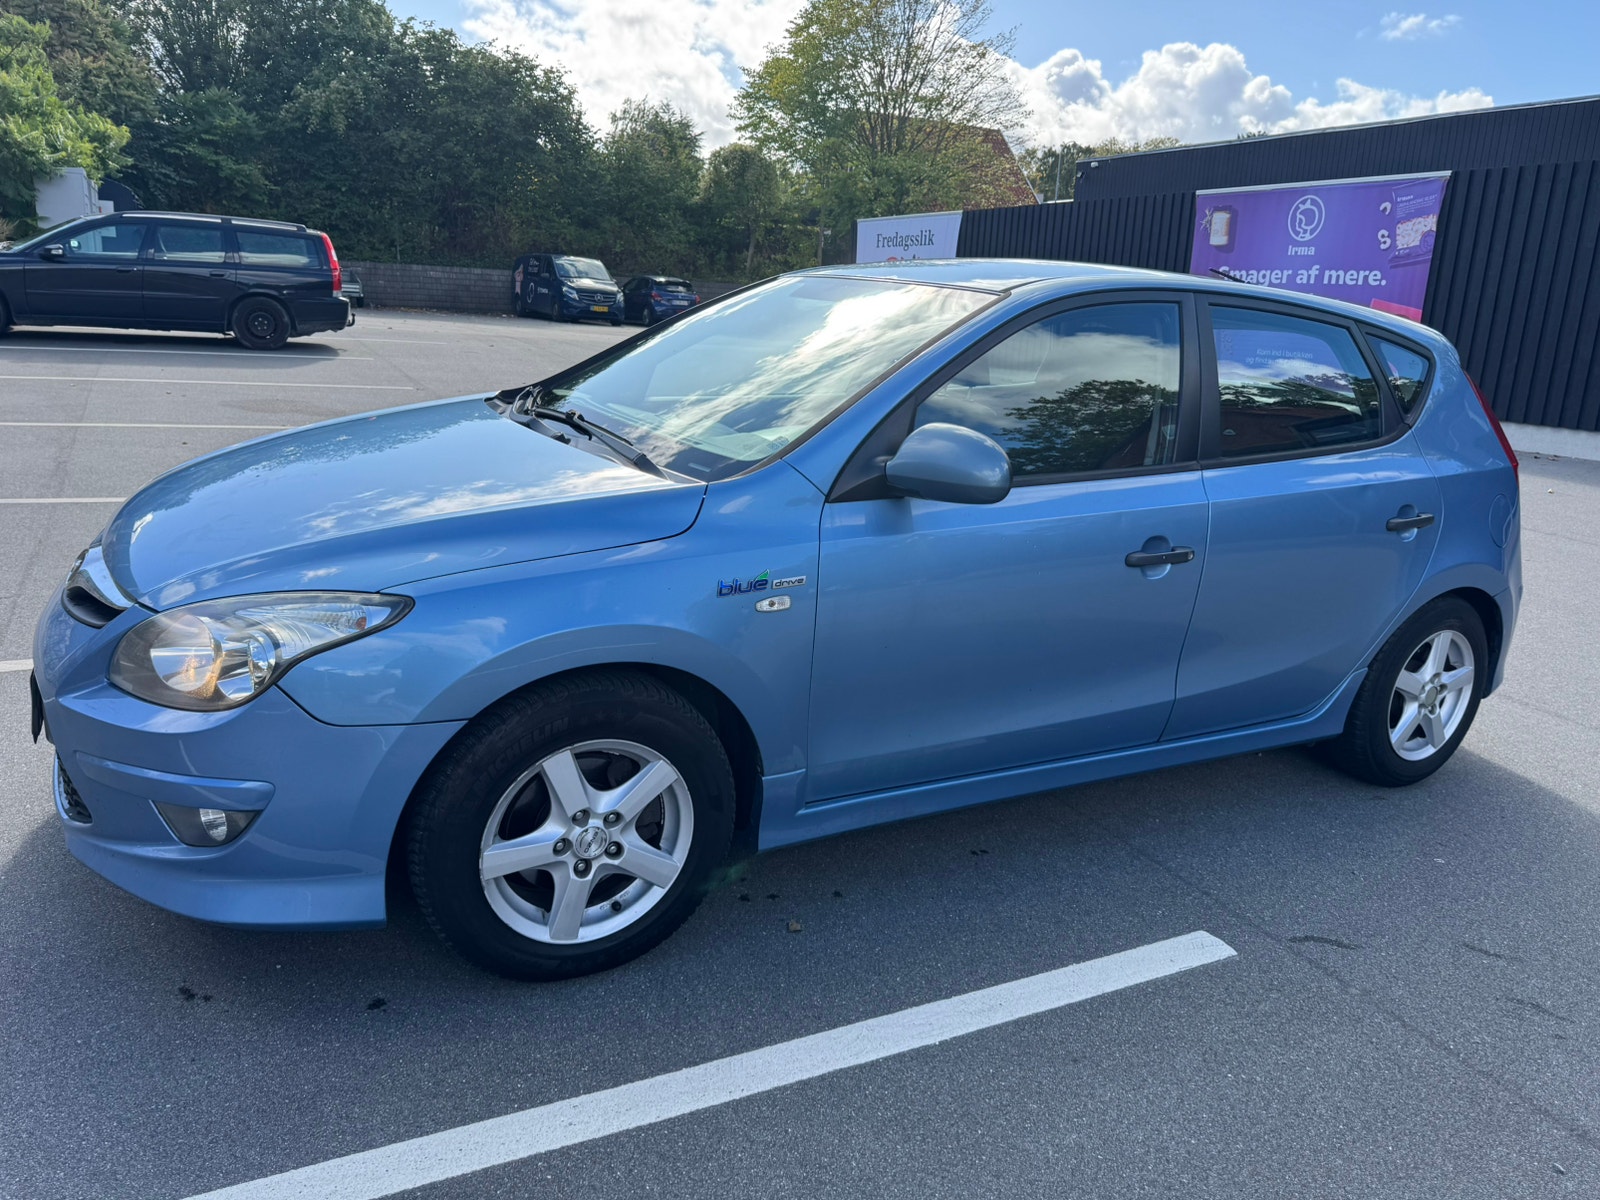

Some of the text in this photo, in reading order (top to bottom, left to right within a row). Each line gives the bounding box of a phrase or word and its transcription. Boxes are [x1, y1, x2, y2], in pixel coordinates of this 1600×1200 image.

[876, 229, 935, 251] Fredagsslik
[1287, 244, 1315, 256] Irma
[1296, 265, 1320, 284] af
[1323, 267, 1387, 286] mere.
[717, 575, 805, 598] blue drive
